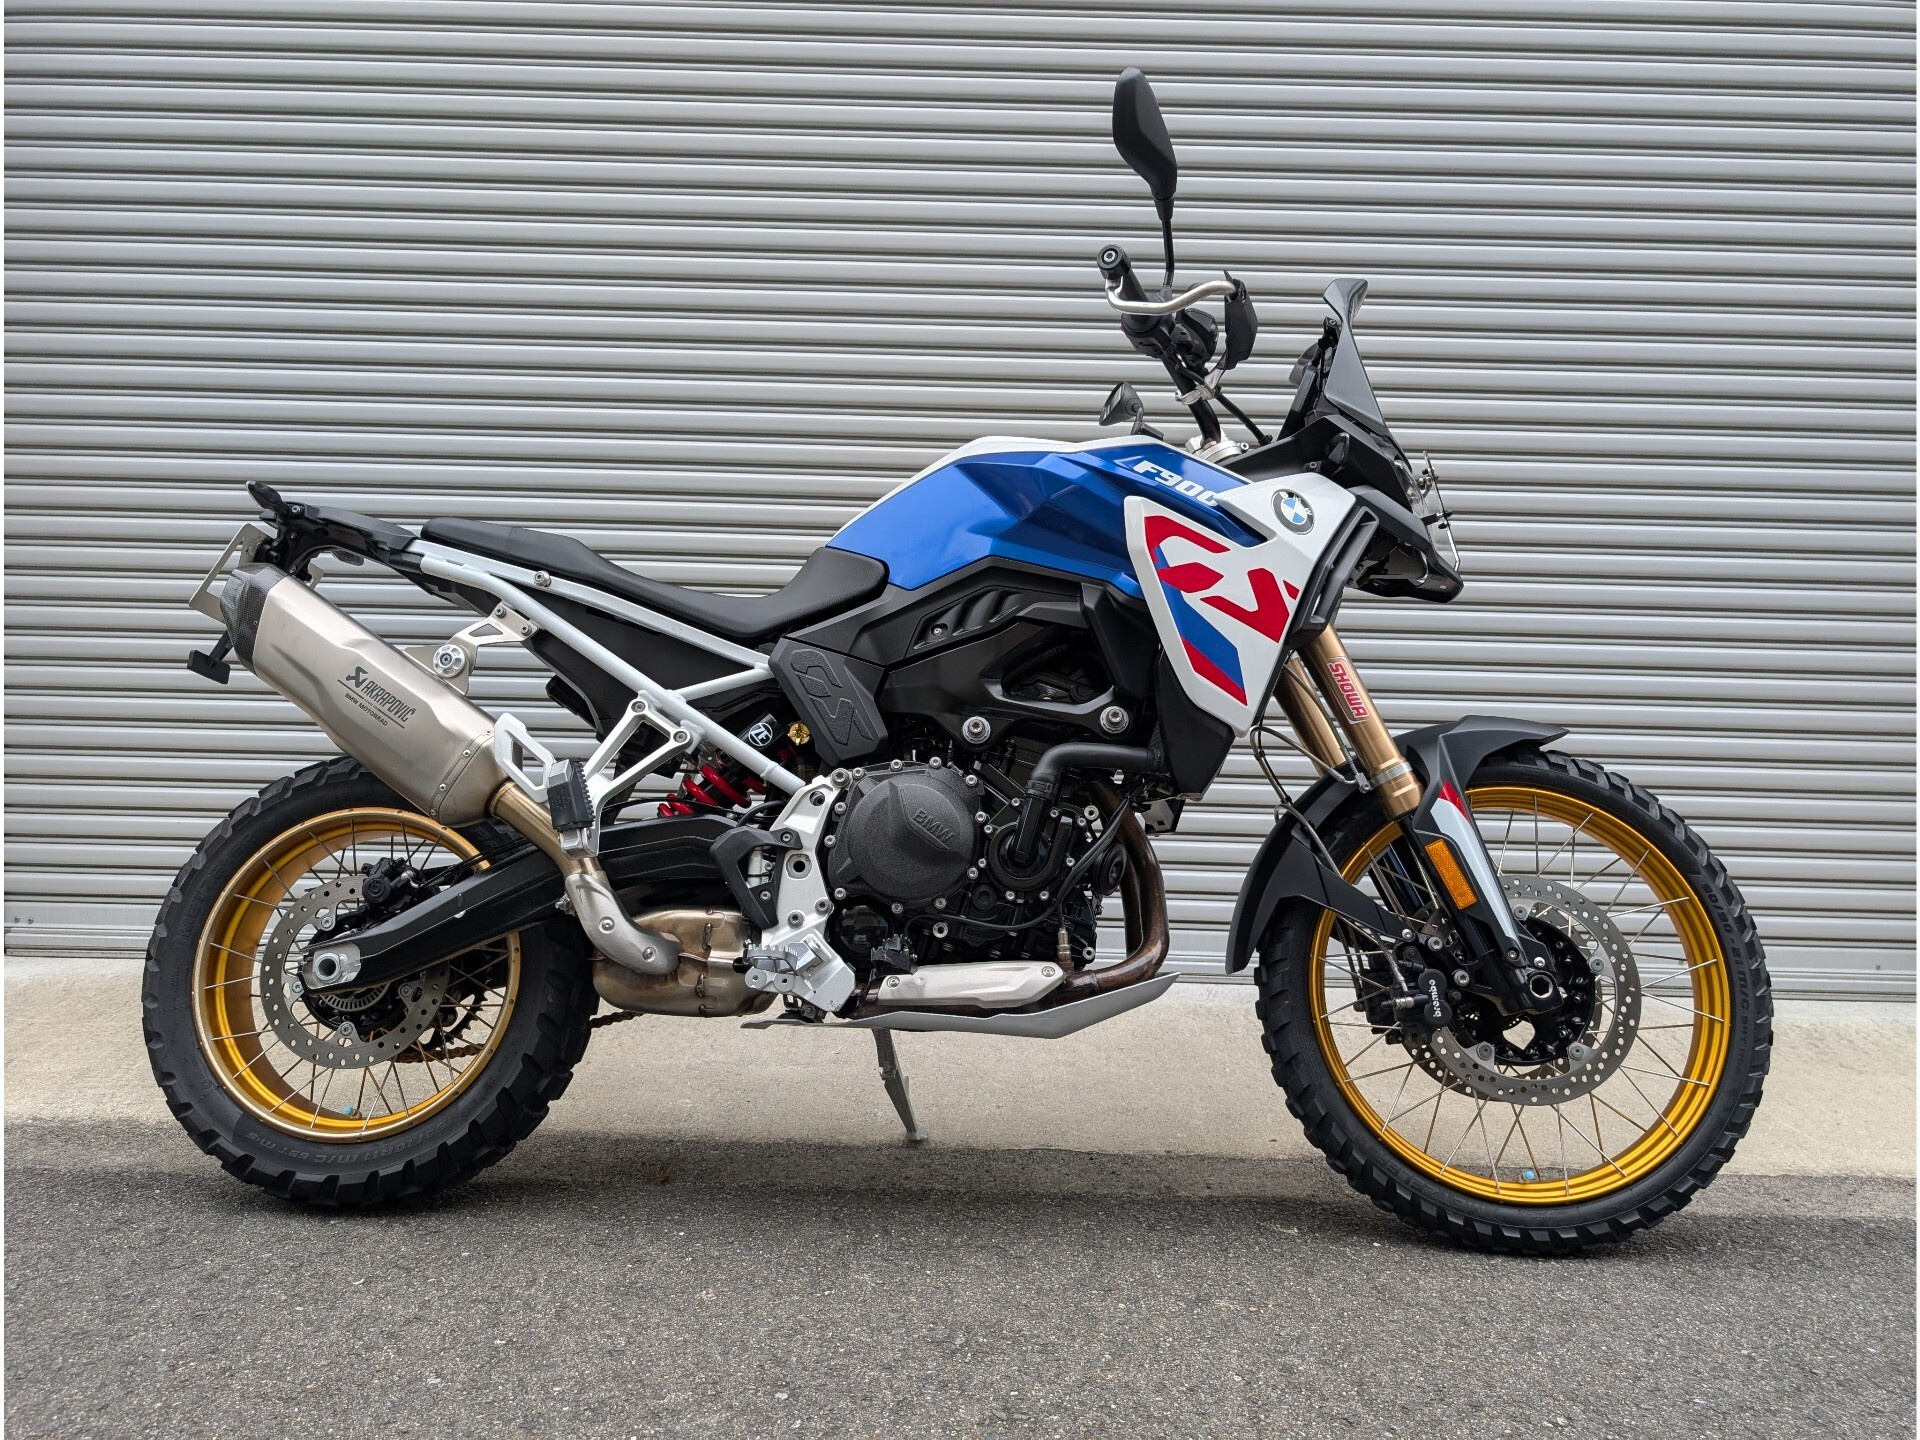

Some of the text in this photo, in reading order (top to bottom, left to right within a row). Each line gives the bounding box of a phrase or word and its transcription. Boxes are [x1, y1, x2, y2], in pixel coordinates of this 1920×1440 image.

[1327, 661, 1369, 718] SHOWA
[344, 692, 360, 705] BMW
[358, 702, 389, 727] MOTORRAD
[749, 722, 773, 746] ZF
[912, 808, 955, 843] BMW
[1428, 979, 1442, 1018] brembo
